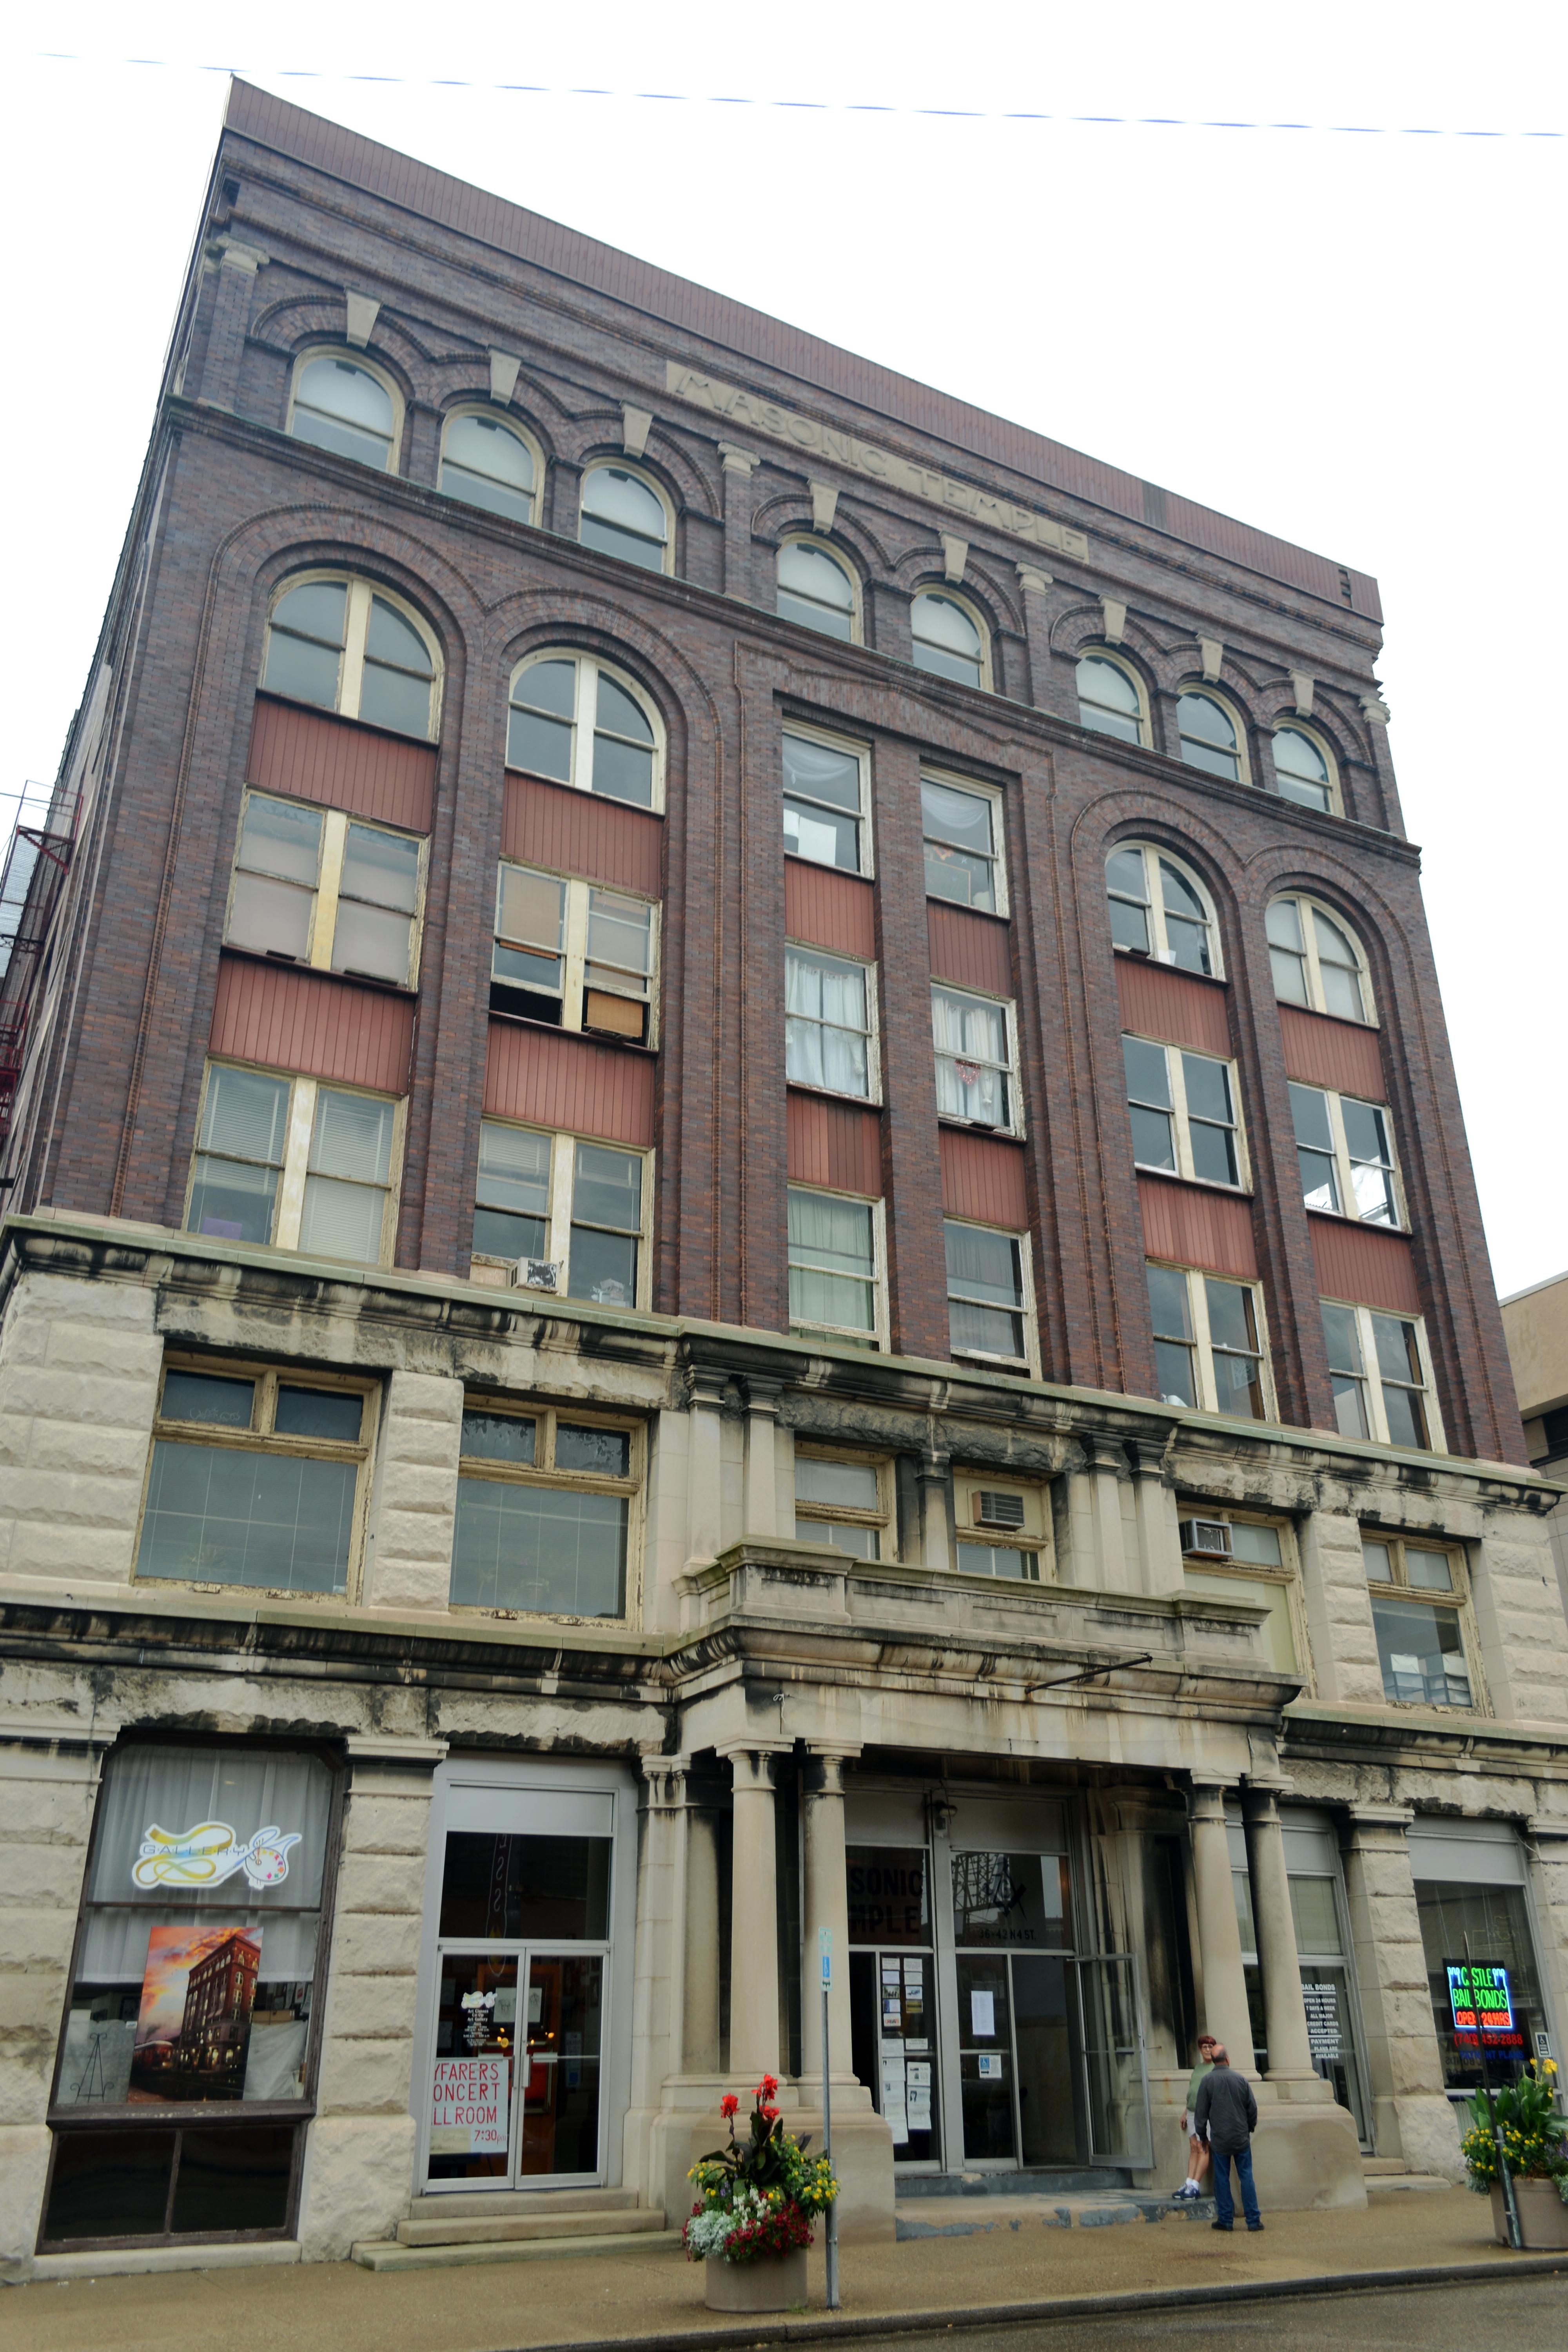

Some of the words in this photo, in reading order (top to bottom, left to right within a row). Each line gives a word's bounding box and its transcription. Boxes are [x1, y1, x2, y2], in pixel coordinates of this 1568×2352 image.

[675, 370, 886, 476] MASONIC
[908, 466, 1085, 560] TEMPLE
[849, 1867, 923, 1896] SONIC
[850, 1904, 919, 1934] MPLE
[1461, 1967, 1494, 1986] CSTLE
[1452, 1988, 1473, 2007] BAIL
[1474, 1989, 1507, 2008] BONDS
[1460, 2050, 1498, 2060] PAYMNT
[1499, 2050, 1524, 2060] PLANS
